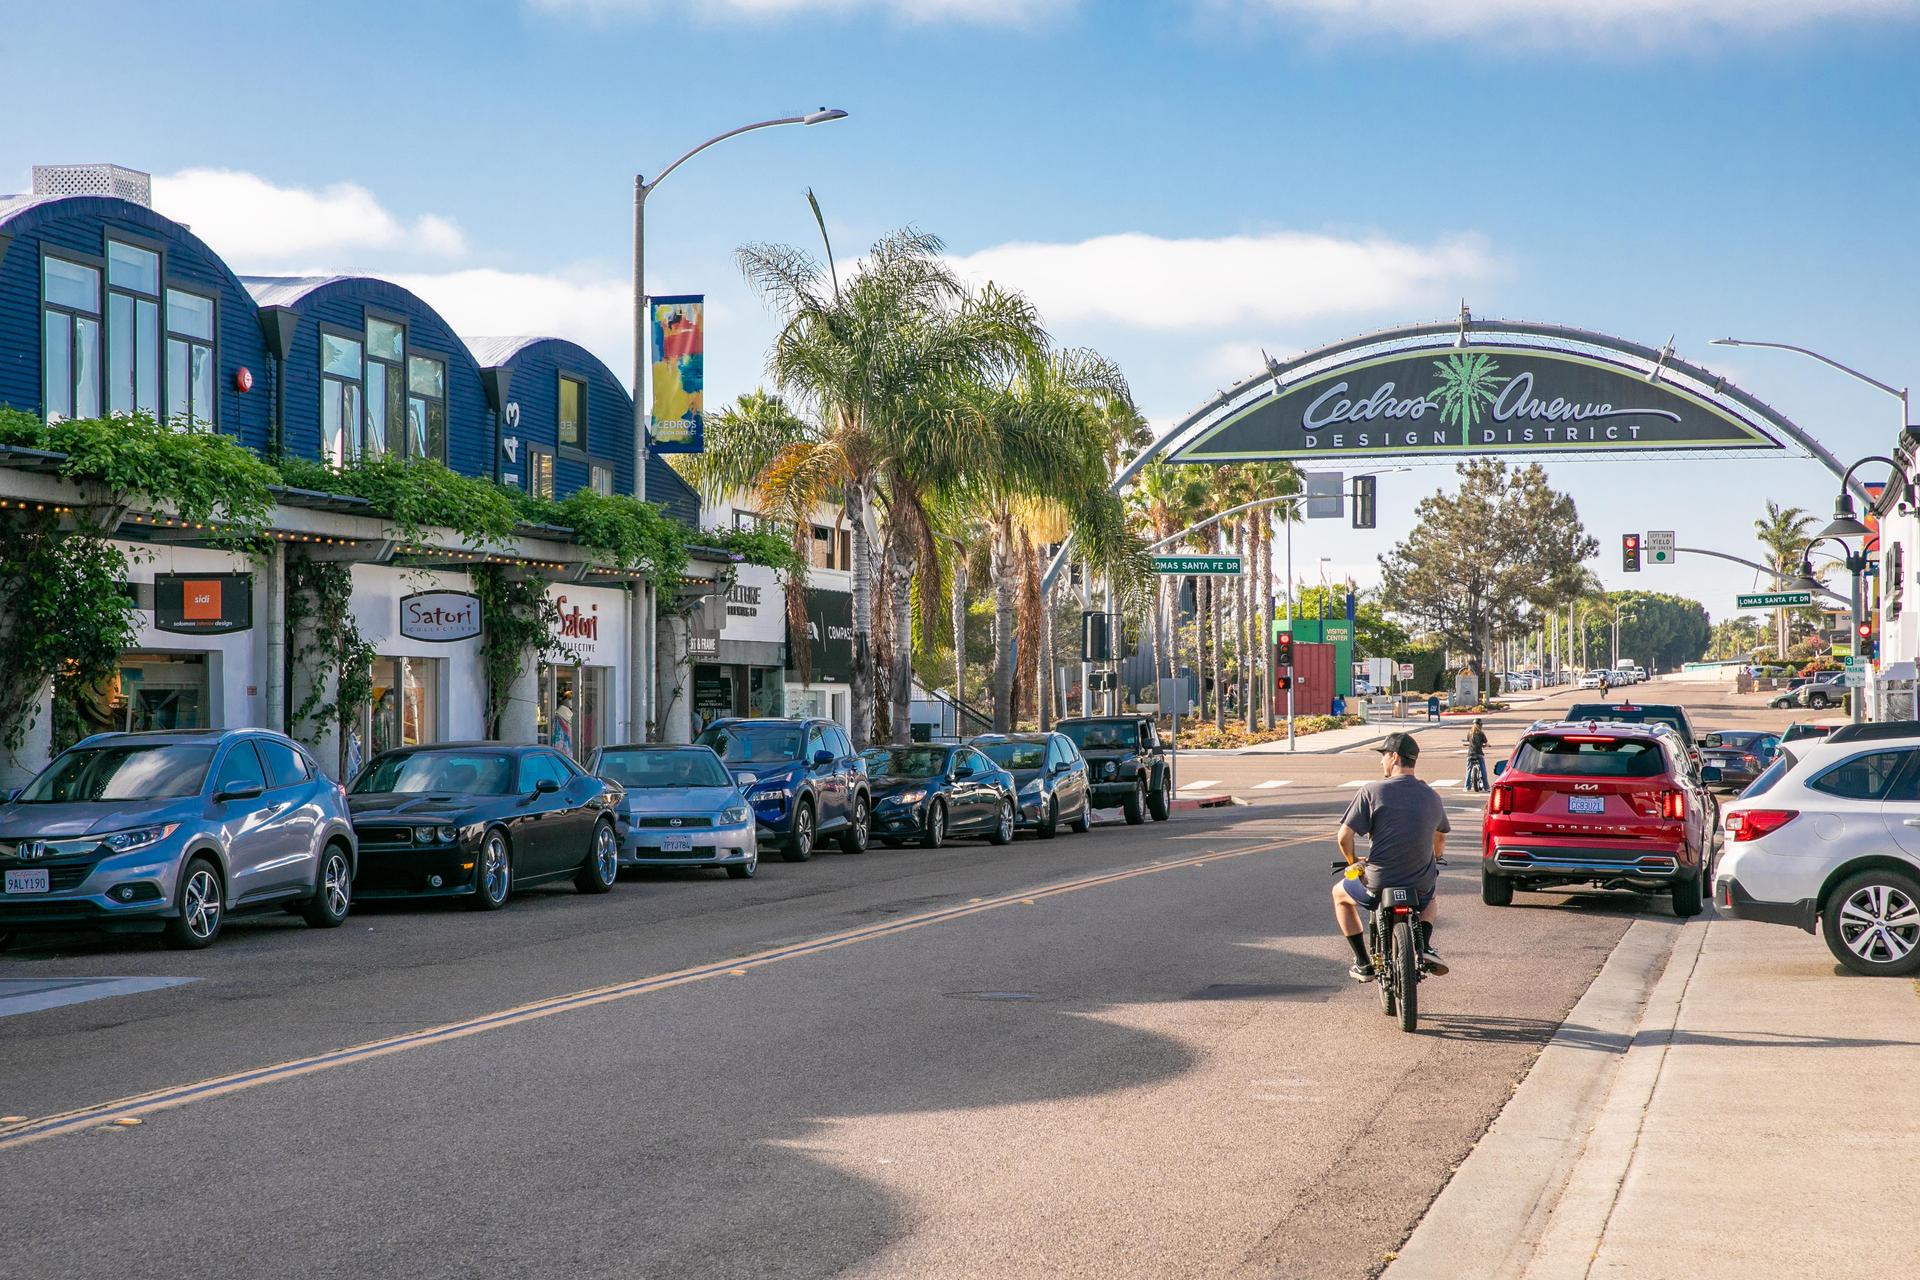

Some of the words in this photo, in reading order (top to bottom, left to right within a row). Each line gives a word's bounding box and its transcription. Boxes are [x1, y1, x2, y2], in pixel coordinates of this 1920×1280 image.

[1303, 381, 1438, 429] Cedros
[1494, 372, 1682, 421] Avenue
[657, 420, 697, 429] CEDROS
[1305, 430, 1446, 448] DESIGN
[1484, 425, 1641, 443] DISTRICT
[1182, 562, 1210, 570] SANTA
[1212, 562, 1224, 570] FE
[1226, 562, 1238, 570] DR
[194, 594, 210, 604] sidi
[409, 602, 471, 626] Satori
[557, 594, 598, 641] Satori
[560, 642, 596, 652] OLLECTIVE
[8, 878, 46, 890] 9ALY190
